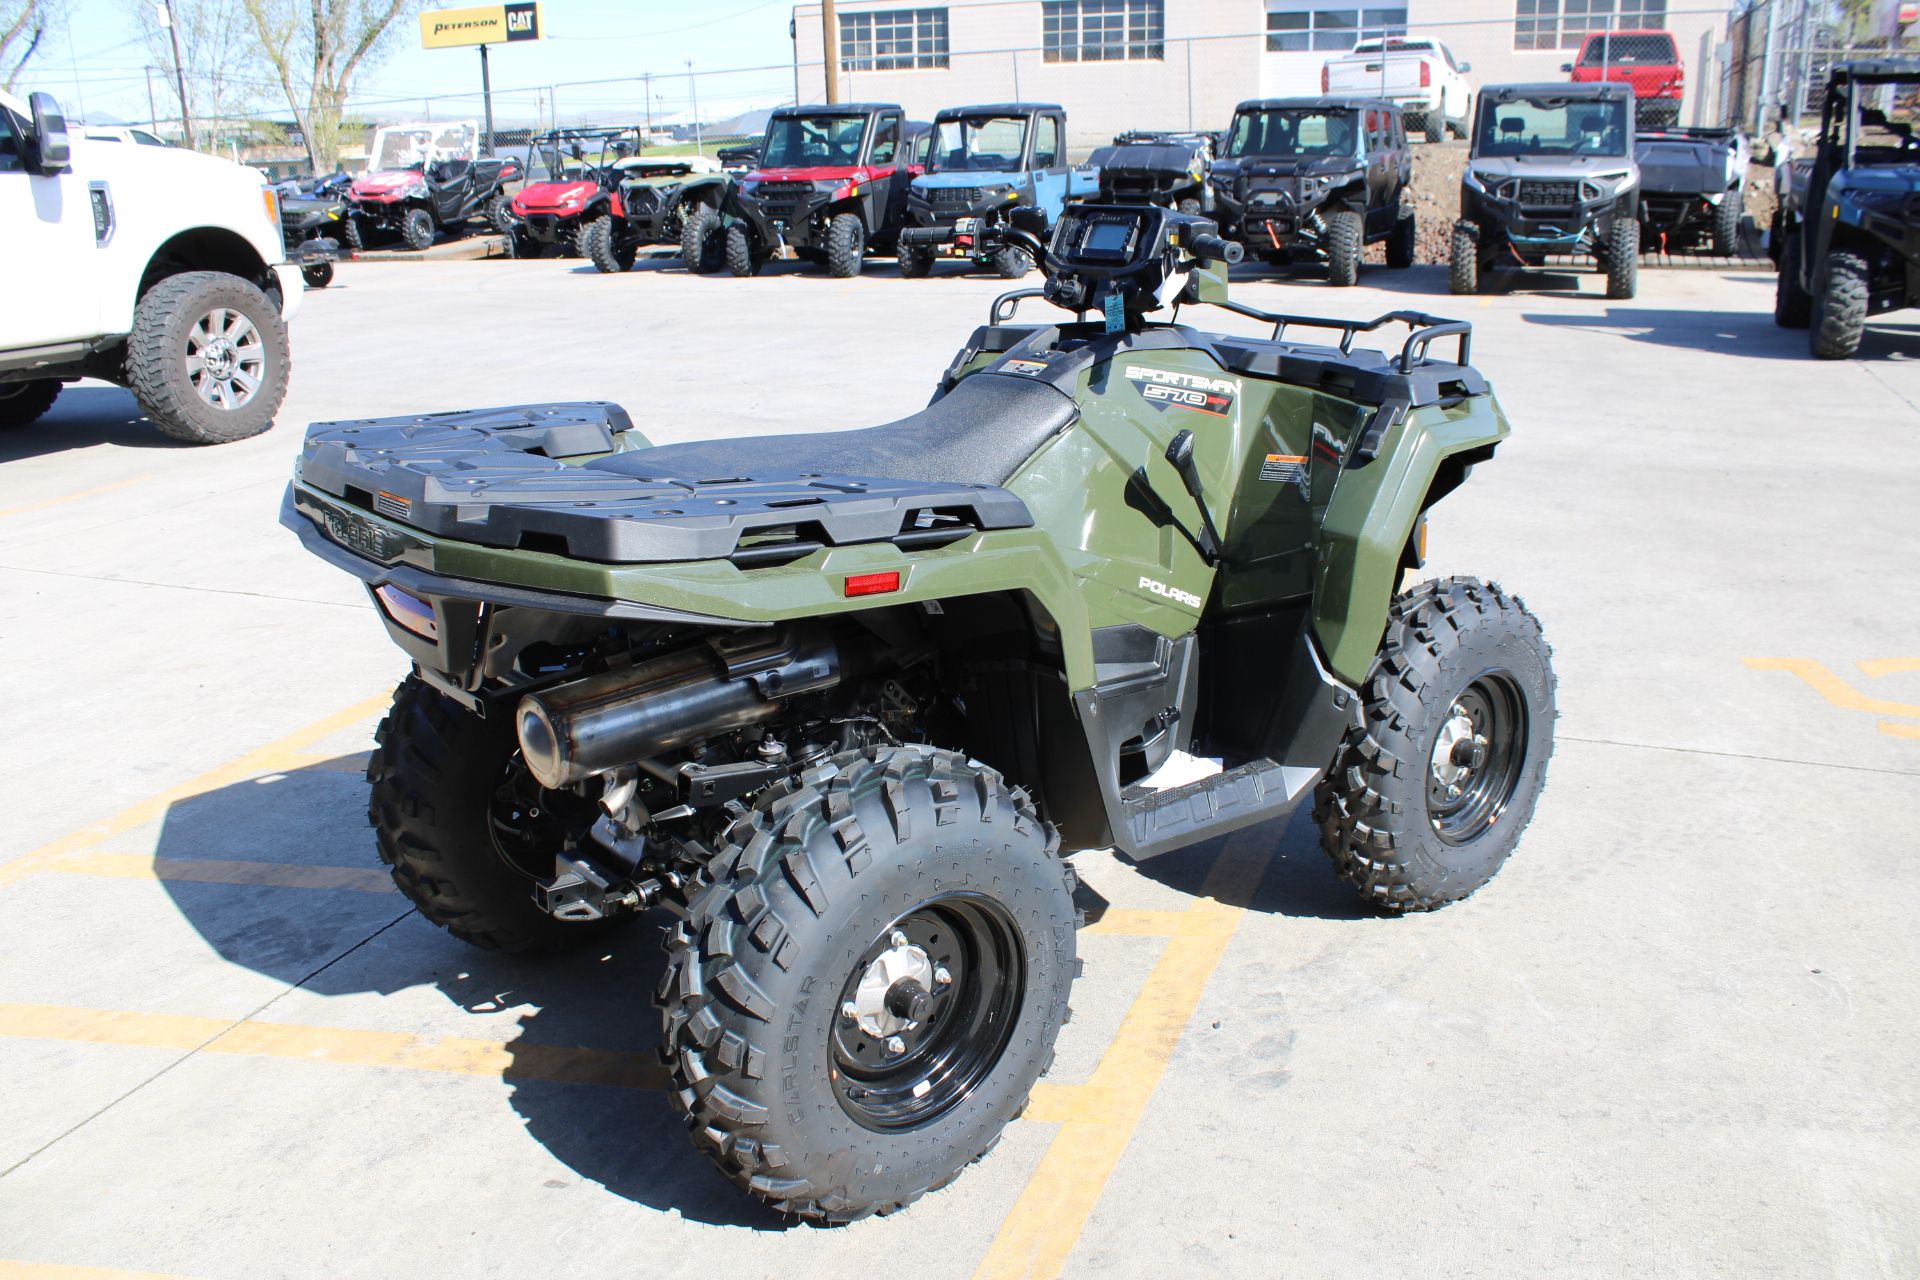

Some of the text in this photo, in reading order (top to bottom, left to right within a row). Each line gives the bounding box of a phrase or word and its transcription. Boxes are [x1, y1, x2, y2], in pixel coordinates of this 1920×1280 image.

[434, 19, 498, 34] PETERSON
[507, 11, 533, 31] CAT
[1124, 366, 1243, 393] SPORTSMAN
[1143, 384, 1208, 406] 570
[1139, 576, 1202, 609] POLARIS
[781, 974, 819, 1126] CARLSTAR
